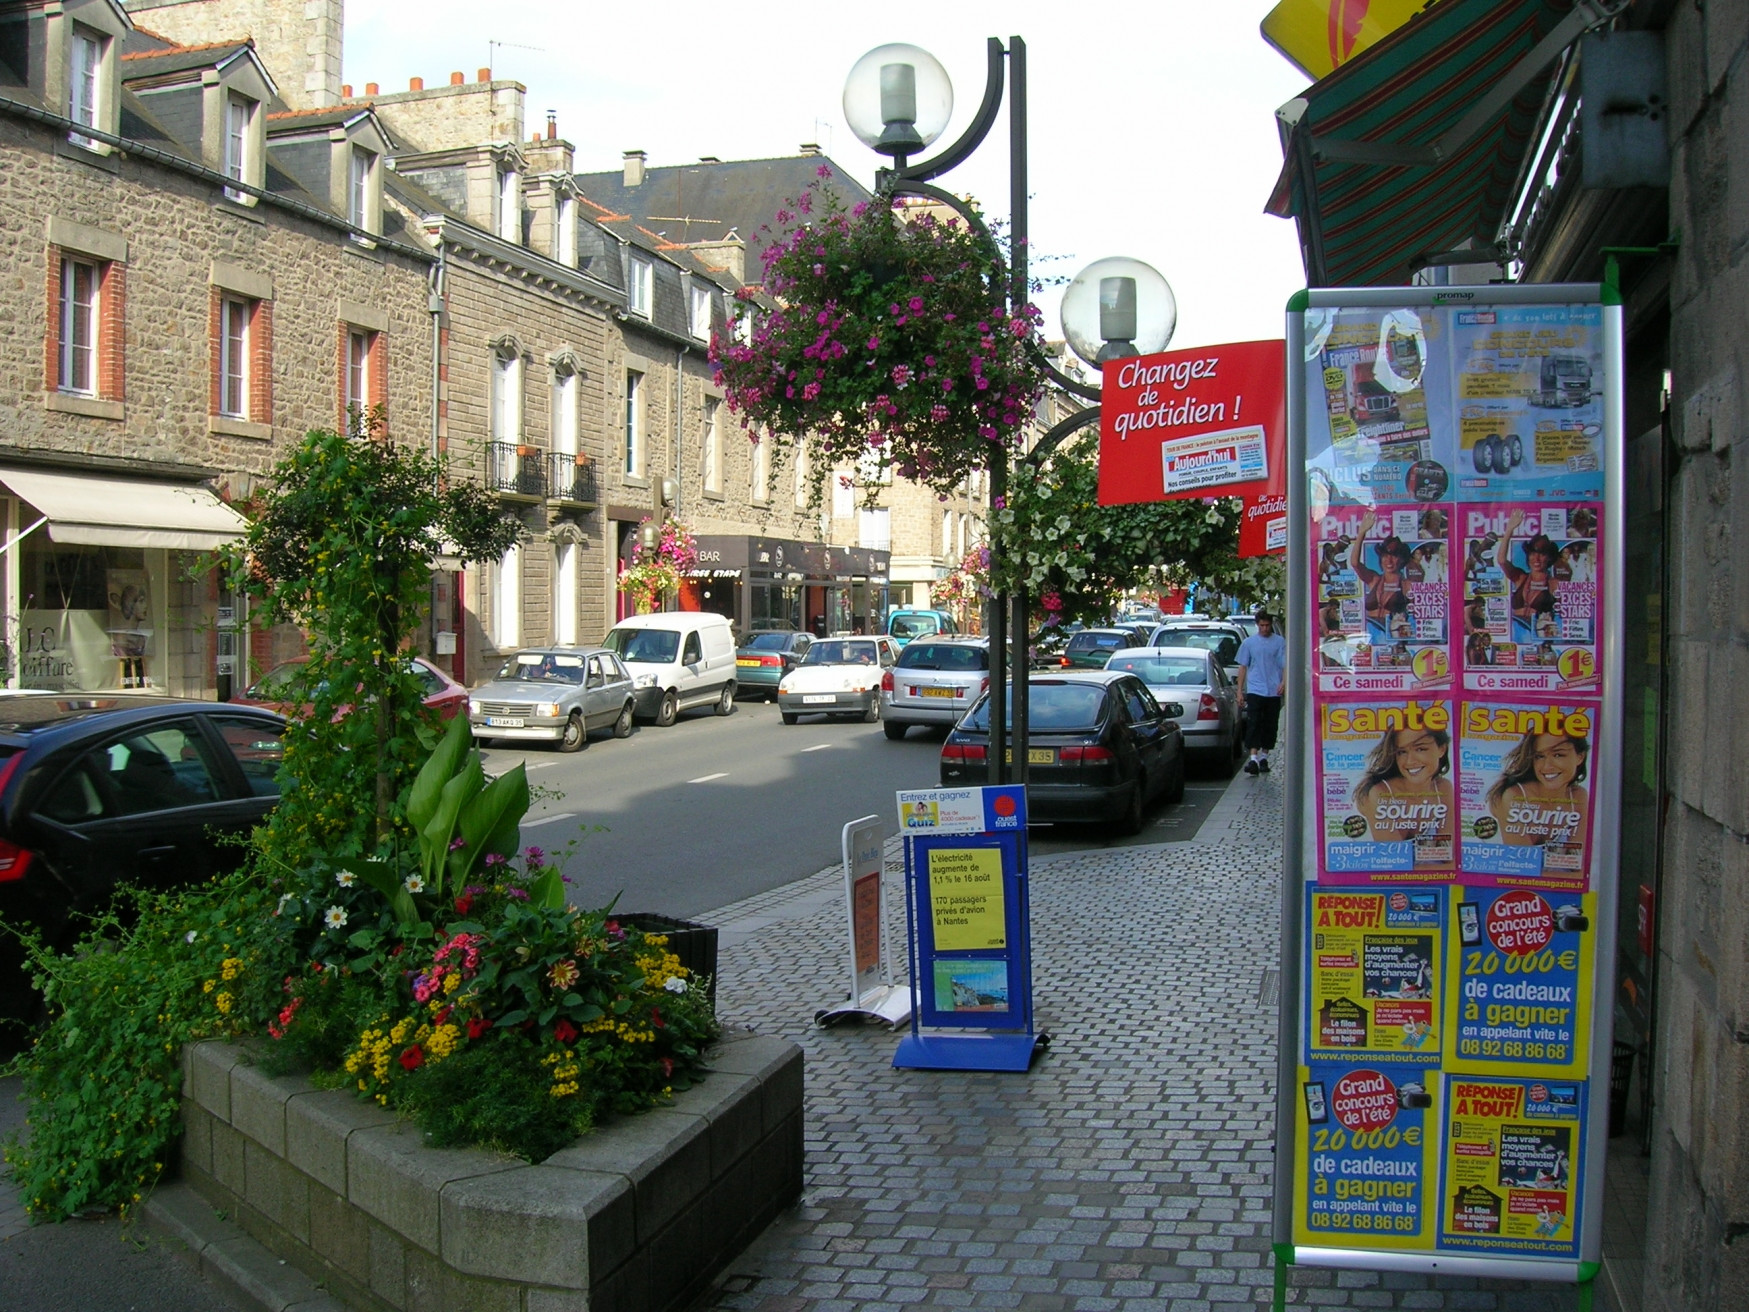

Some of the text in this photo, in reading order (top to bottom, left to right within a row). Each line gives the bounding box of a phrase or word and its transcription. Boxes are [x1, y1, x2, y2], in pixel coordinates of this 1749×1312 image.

[1437, 292, 1474, 300] promap
[1473, 339, 1576, 350] CONCOURS
[1329, 349, 1360, 367] France
[1118, 357, 1219, 390] Changez
[1138, 386, 1158, 406] de
[1114, 395, 1242, 440] quotidien !
[1174, 449, 1231, 471] Aujourd'hui
[1373, 467, 1391, 475] DANS
[1178, 477, 1201, 486] conseils
[1215, 471, 1237, 482] profiter
[1248, 496, 1286, 522] quotidie
[700, 551, 720, 561] BAR
[1411, 582, 1448, 592] VACANCES
[1557, 581, 1595, 592] VACANCES
[1414, 605, 1445, 618] STARS
[1561, 605, 1592, 618] STARS
[22, 656, 73, 677] oiffure
[1334, 675, 1404, 689] Ce samedi
[1477, 674, 1549, 688] Ce samedi
[1329, 700, 1449, 733] santé
[1469, 705, 1590, 738] santé
[1040, 752, 1052, 761] 35
[1326, 752, 1364, 760] Cancer
[1462, 751, 1502, 761] Cancer
[901, 791, 971, 802] Entrez et gagnez
[1375, 800, 1447, 820] sourire
[1507, 806, 1580, 826] sourire
[907, 817, 935, 828] Quiz
[1390, 821, 1417, 832] juste
[1419, 821, 1439, 832] prix
[1505, 823, 1571, 837] au juste prix
[1331, 843, 1376, 856] maigrir
[1380, 842, 1409, 855] zen
[1462, 844, 1505, 858] maigrir
[1507, 846, 1539, 859] zen
[931, 853, 973, 862] L'électricité
[1498, 860, 1537, 869] l'olfacto-
[932, 863, 980, 875] augmente de
[964, 873, 990, 883] 16 août
[1370, 872, 1457, 882] www.santemagazine.fr
[1497, 877, 1584, 889] www.santemagazine.fr
[936, 895, 987, 907] 170 passagers
[1494, 896, 1541, 917] Grand
[935, 905, 985, 916] privés d'avion
[943, 917, 969, 926] Nantes
[1334, 911, 1375, 928] TOUT
[1489, 914, 1550, 934] concours
[1497, 928, 1546, 947] de l'été
[1382, 945, 1403, 953] vrais
[1365, 954, 1398, 962] moyens
[1365, 960, 1419, 969] d'augmenter
[1465, 949, 1577, 975] 20 000 €
[1381, 969, 1417, 977] chances
[1465, 978, 1571, 1002] de cadeaux
[1464, 998, 1570, 1028] à gagner
[1336, 1027, 1365, 1035] maisons
[1341, 1034, 1356, 1042] bois
[1463, 1026, 1569, 1041] en appelant vite le
[1461, 1039, 1479, 1055] 08
[1482, 1040, 1500, 1056] 92
[1503, 1041, 1522, 1057] 68
[1525, 1042, 1543, 1058] 86
[1310, 1052, 1440, 1063] www.reponseatout.com
[1340, 1075, 1385, 1096] Grand
[1335, 1093, 1395, 1112] concours
[1472, 1100, 1515, 1118] TOUT
[1344, 1106, 1391, 1125] de l'été
[1313, 1126, 1421, 1152] 20 000 €
[1502, 1135, 1541, 1144] Les vrais
[1501, 1150, 1556, 1159] d'augmenter
[1502, 1143, 1535, 1152] moyens
[1313, 1154, 1417, 1177] de cadeaux
[1517, 1159, 1554, 1168] chances
[1314, 1173, 1416, 1200] à gagner
[1313, 1199, 1417, 1213] en appelant vite le
[1311, 1212, 1330, 1227] 08
[1332, 1212, 1350, 1228] 92
[1352, 1213, 1371, 1229] 68
[1374, 1214, 1392, 1230] 86
[1474, 1221, 1488, 1229] bois
[1442, 1236, 1573, 1252] www.reponseatout.com
